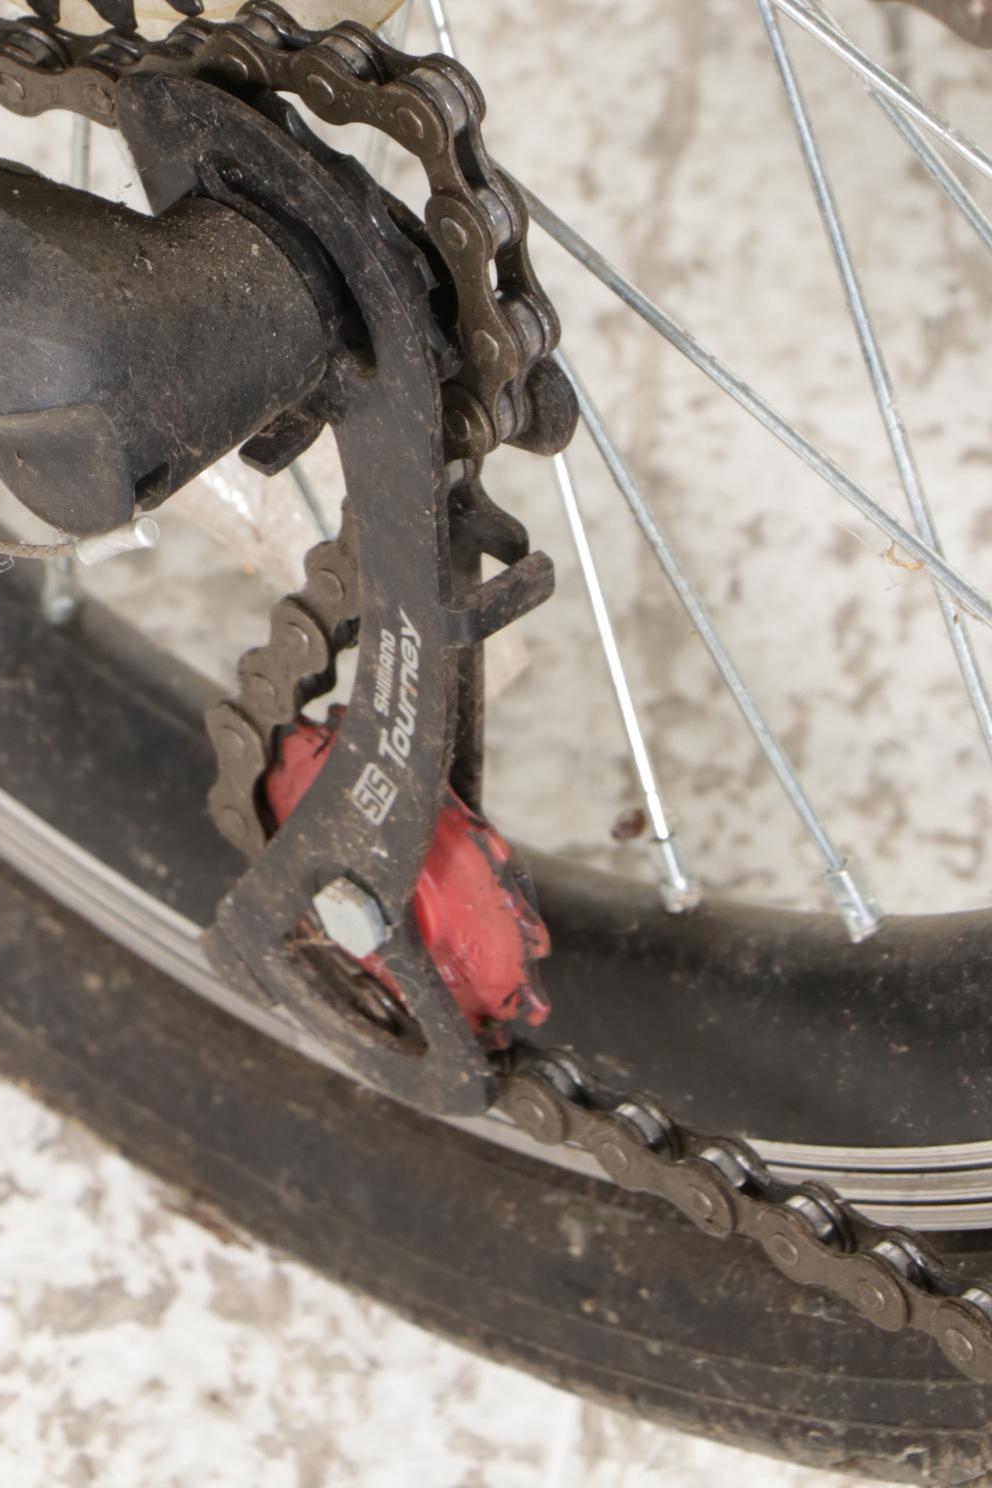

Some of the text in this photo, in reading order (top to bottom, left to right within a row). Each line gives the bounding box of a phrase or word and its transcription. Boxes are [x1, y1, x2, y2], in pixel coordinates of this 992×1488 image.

[374, 628, 397, 716] SHIMANO
[379, 606, 422, 768] Tourney
[357, 766, 396, 821] SIS
